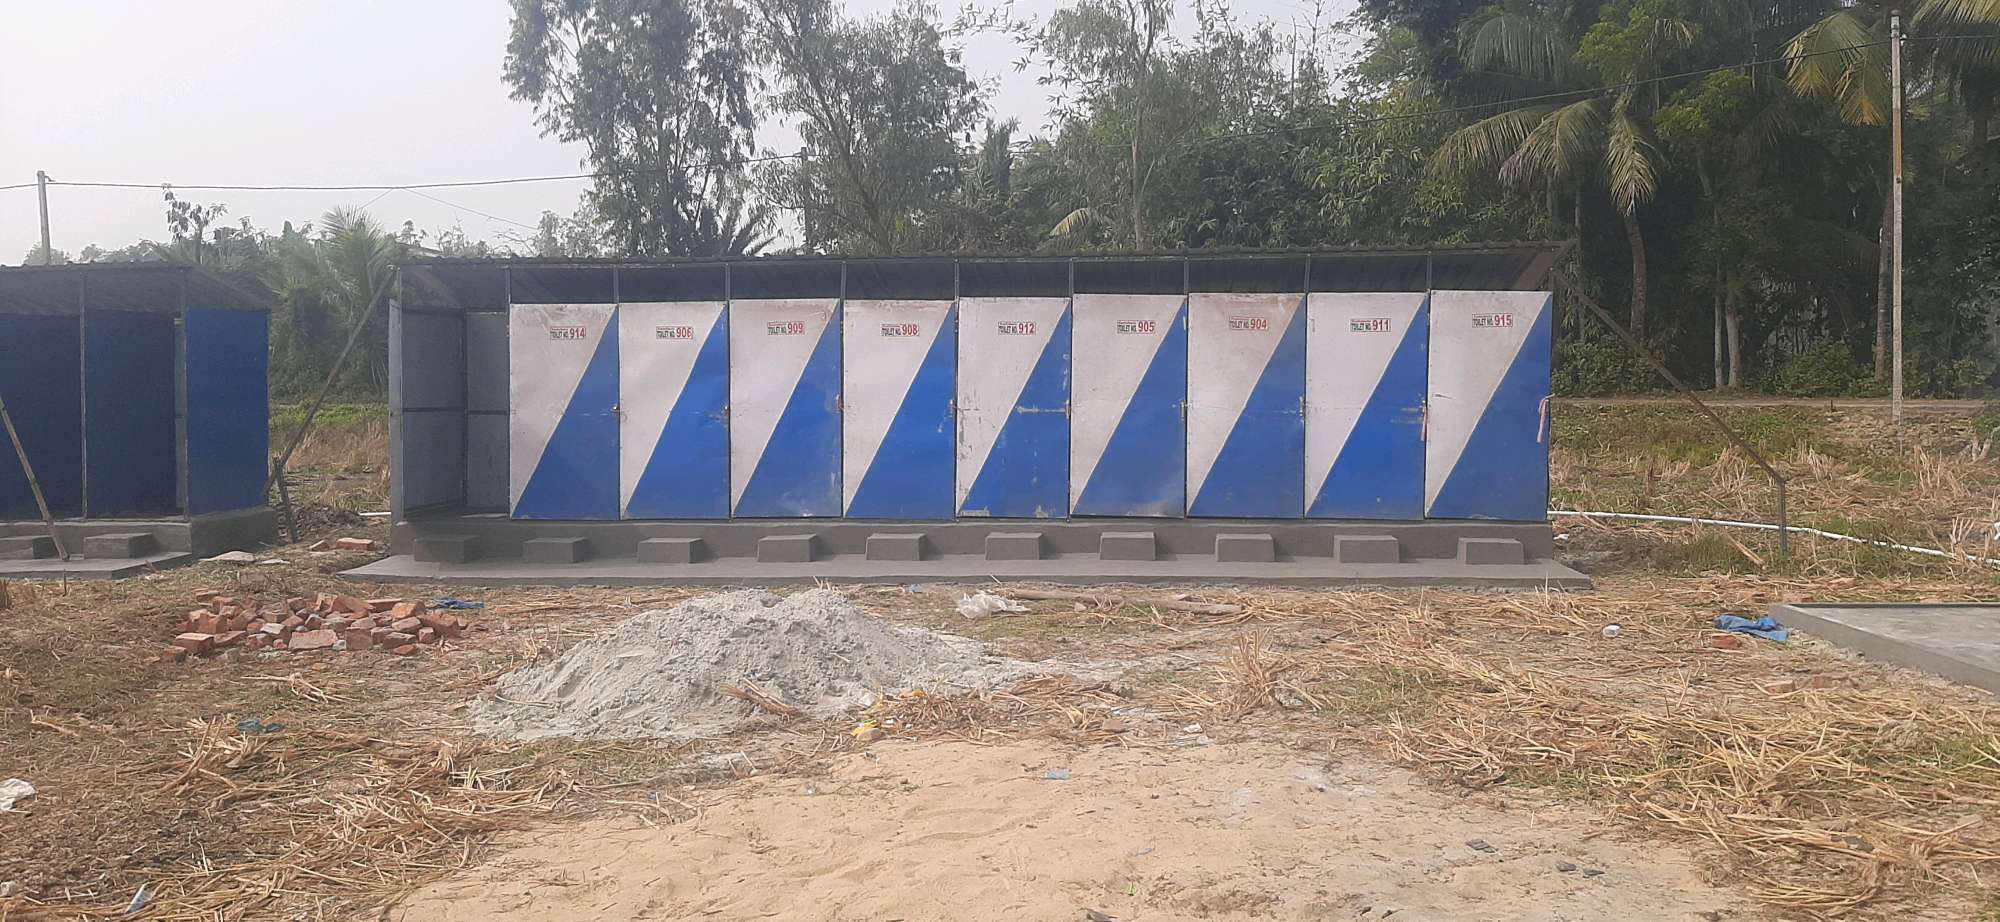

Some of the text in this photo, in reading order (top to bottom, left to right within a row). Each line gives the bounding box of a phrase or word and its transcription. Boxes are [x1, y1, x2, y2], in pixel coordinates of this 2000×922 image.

[1251, 319, 1266, 328] 904
[1373, 320, 1388, 330] 911
[1494, 315, 1511, 326] 915
[788, 323, 803, 333] 909
[902, 324, 917, 335] 908
[1019, 323, 1034, 334] 912
[1138, 321, 1154, 332] 905
[570, 328, 584, 338] 914
[676, 327, 692, 337] 906
